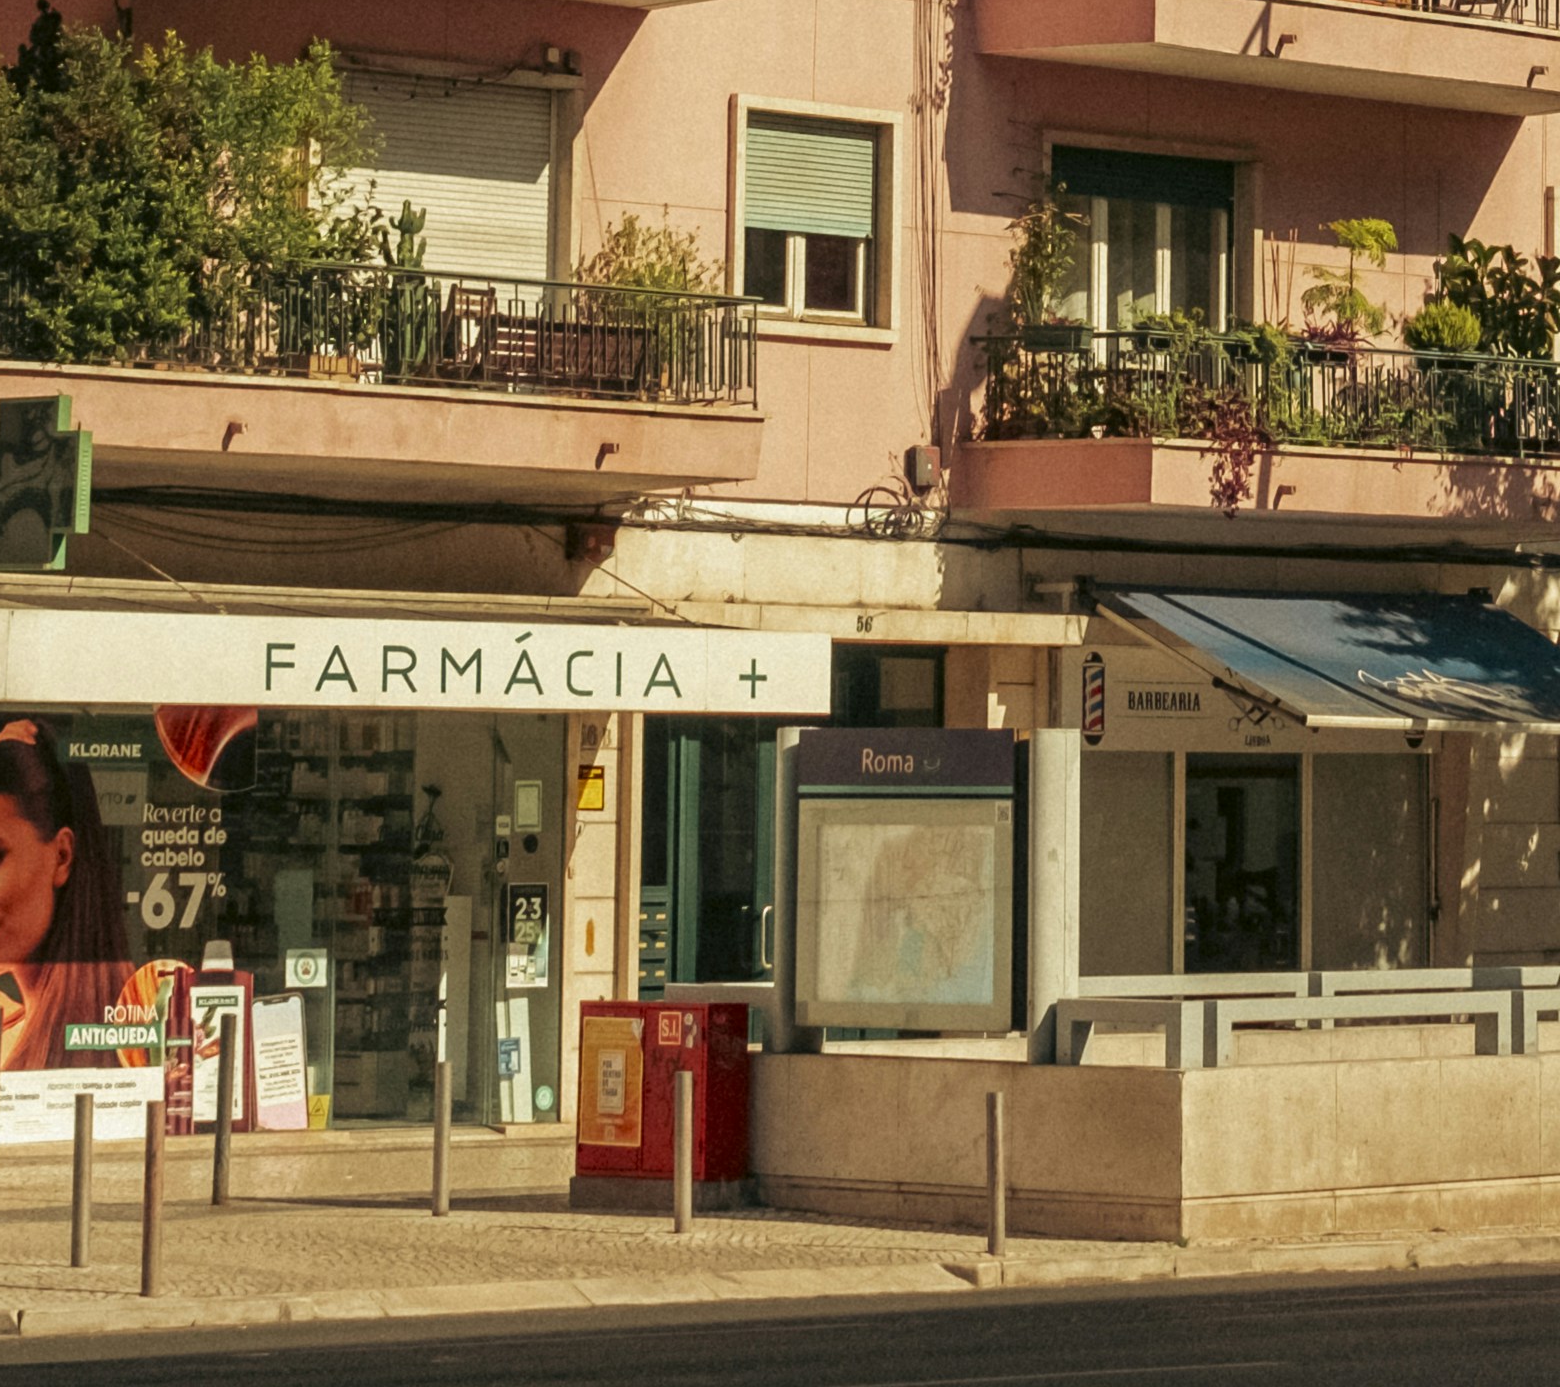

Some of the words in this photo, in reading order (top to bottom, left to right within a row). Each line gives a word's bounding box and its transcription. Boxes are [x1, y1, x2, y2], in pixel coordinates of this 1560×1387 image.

[856, 614, 874, 633] 56
[265, 631, 683, 698] FARMÁCIA
[1128, 690, 1201, 711] BARBEARIA
[69, 742, 142, 758] KLORANE
[861, 746, 915, 774] Roma
[143, 803, 207, 824] Reverte
[209, 810, 223, 824] a
[141, 829, 200, 848] queda
[203, 828, 228, 845] de
[141, 848, 206, 867] cabelo
[104, 1005, 159, 1025] ROTINA
[69, 1026, 159, 1046] ANTIQUEDA
